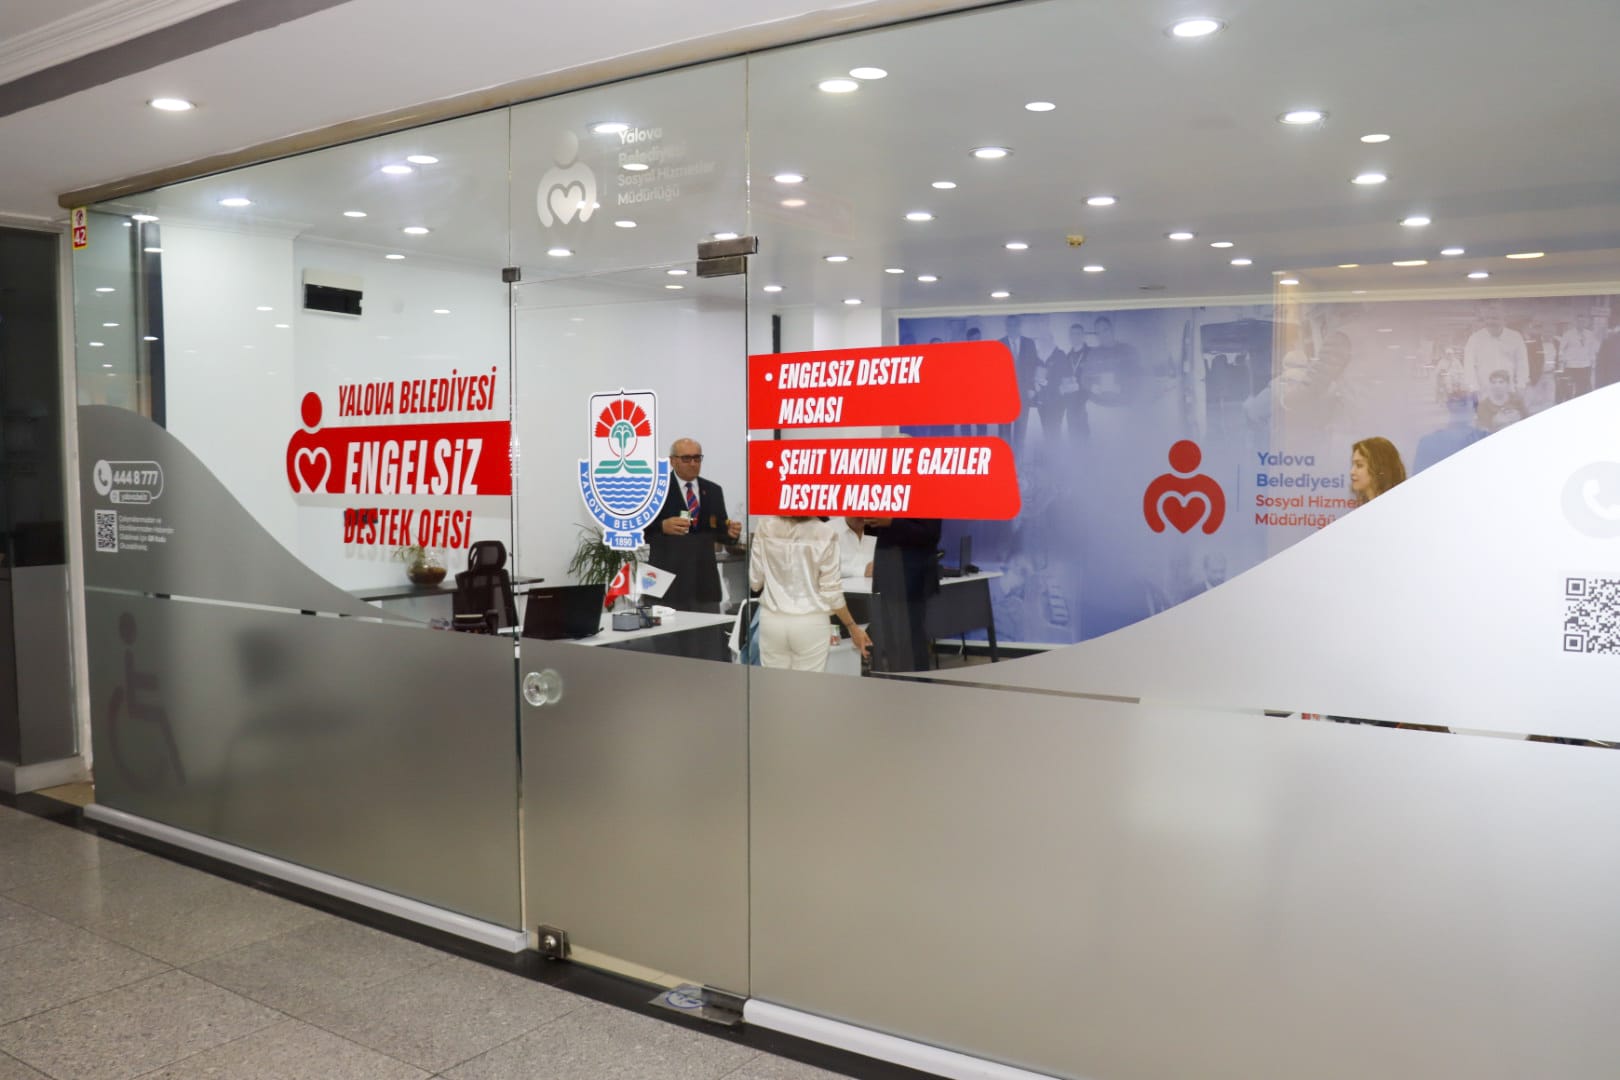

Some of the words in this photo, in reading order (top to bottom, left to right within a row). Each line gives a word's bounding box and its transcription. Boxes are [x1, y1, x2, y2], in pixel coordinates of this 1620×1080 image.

[619, 126, 664, 145] Yalova
[617, 184, 680, 206] Müdürlüğü
[75, 228, 87, 245] 42
[856, 355, 924, 387] DESTEK
[338, 381, 394, 417] YALOVA
[398, 366, 497, 415] BELEDİYESİ
[778, 396, 844, 425] MASASI
[829, 448, 887, 476] YAKINI
[890, 447, 914, 475] VE
[1257, 451, 1316, 467] Yalova
[112, 470, 132, 486] 444
[134, 470, 140, 486] 8
[141, 470, 159, 486] 777
[1256, 473, 1345, 492] Belediyesi
[581, 471, 607, 522] YALOVA
[778, 484, 842, 511] DESTEK
[842, 484, 911, 513] MASASI
[1255, 494, 1305, 510] Sosyal
[1308, 495, 1358, 510] Hizme
[343, 508, 414, 547] DESTEK
[1254, 512, 1337, 530] Müdürlüğü
